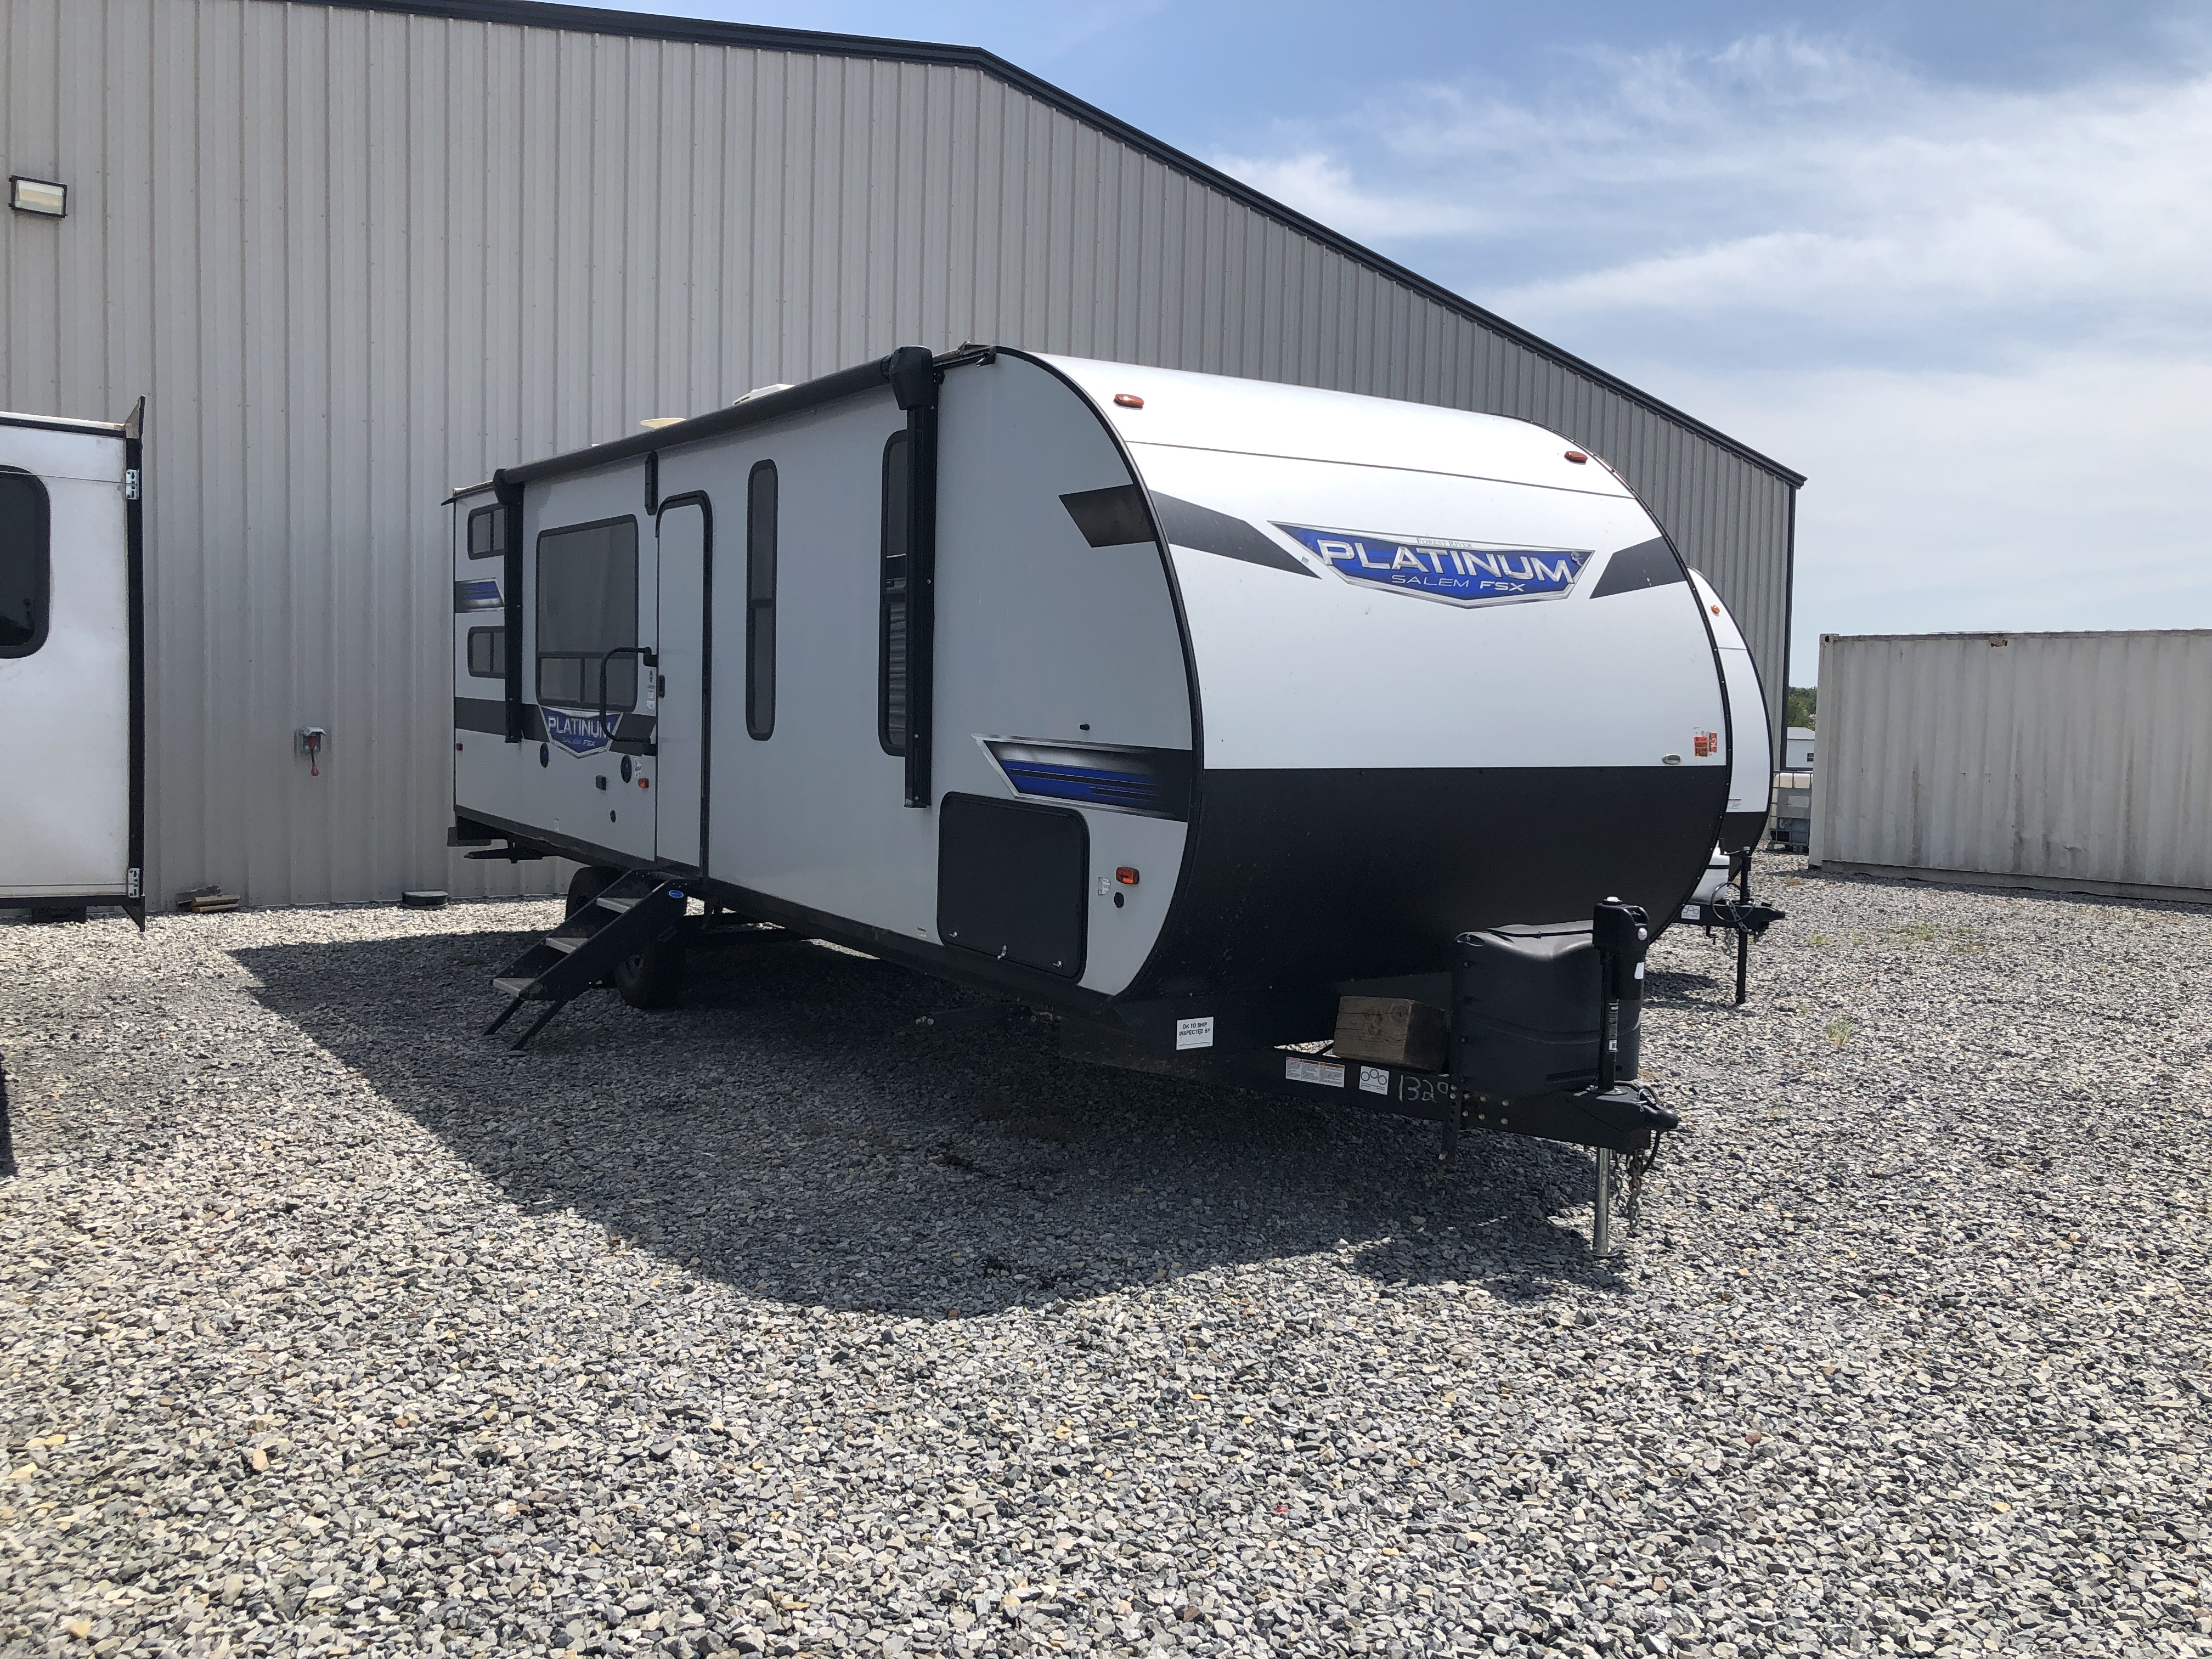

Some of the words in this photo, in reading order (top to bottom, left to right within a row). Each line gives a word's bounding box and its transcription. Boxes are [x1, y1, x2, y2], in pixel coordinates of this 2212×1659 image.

[1416, 538, 1446, 546] FOREST
[1317, 539, 1575, 584] PLATINUM
[1391, 574, 1470, 588] SALEM
[1479, 580, 1526, 592] FSX
[562, 736, 582, 744] SALEM
